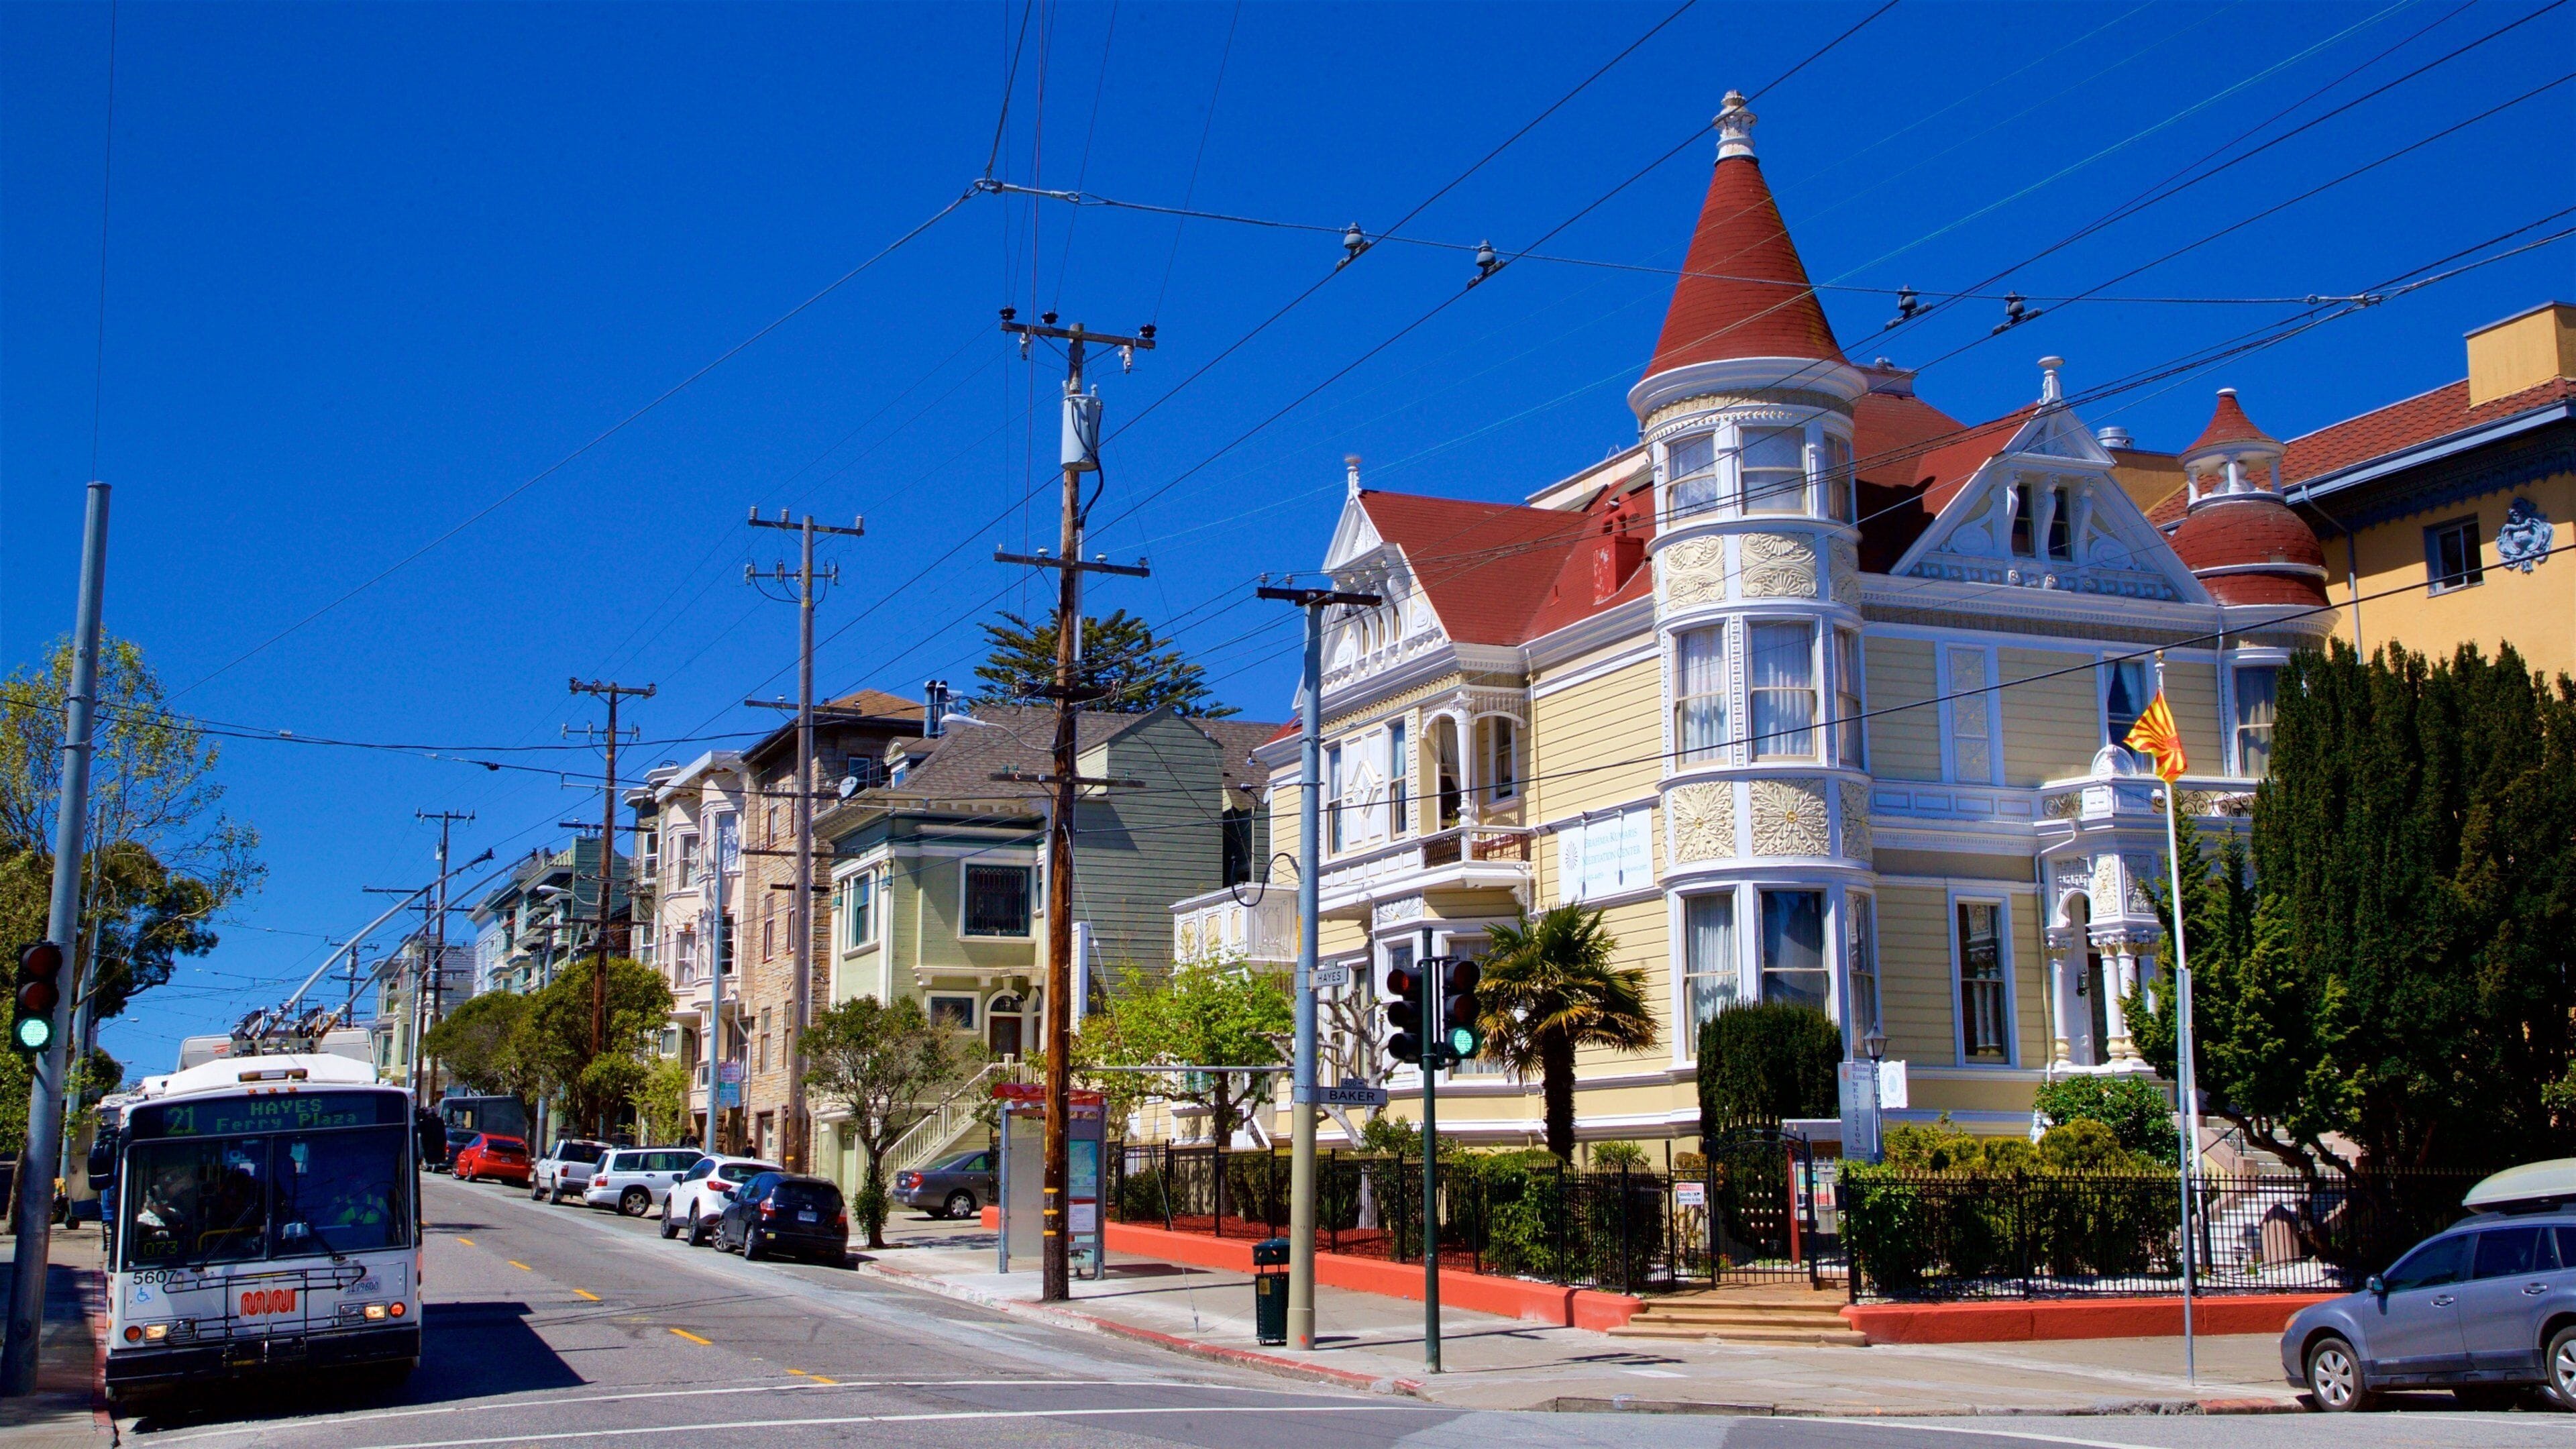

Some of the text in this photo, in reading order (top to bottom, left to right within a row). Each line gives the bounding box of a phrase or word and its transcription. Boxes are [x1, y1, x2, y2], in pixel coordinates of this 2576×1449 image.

[1582, 845, 1640, 865] MEDITATION CENTER
[1318, 971, 1341, 983] HAYES
[1330, 1090, 1375, 1102] BAKER
[250, 1098, 322, 1116] HAYES
[168, 1106, 197, 1135] 21
[217, 1112, 358, 1132] Ferry Plaza
[133, 1270, 178, 1285] 5607
